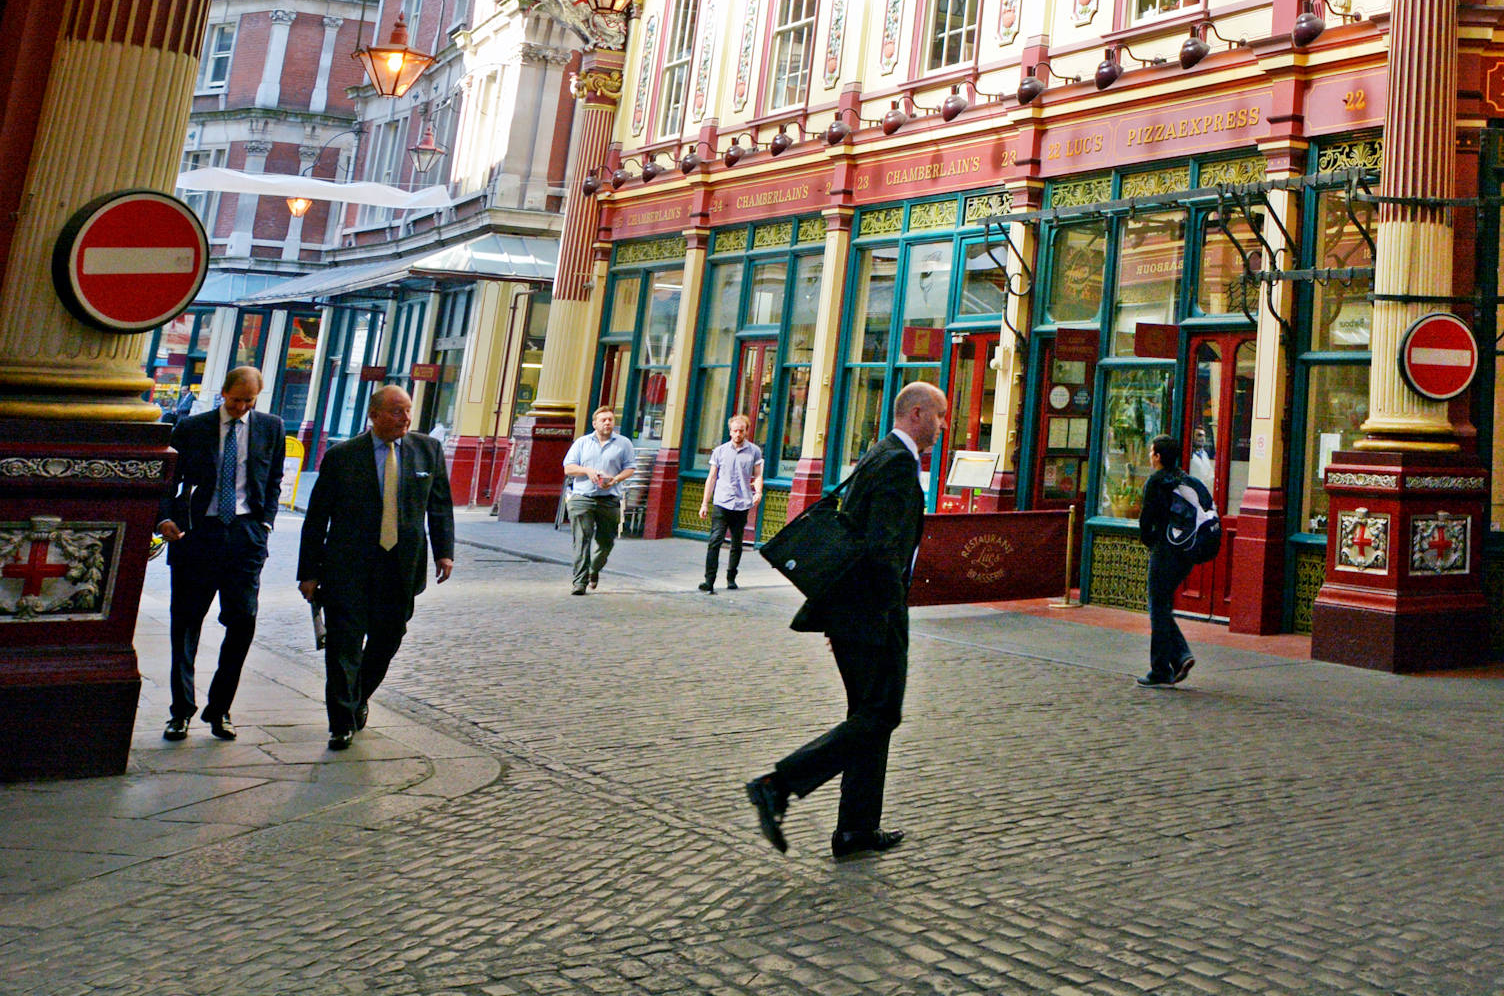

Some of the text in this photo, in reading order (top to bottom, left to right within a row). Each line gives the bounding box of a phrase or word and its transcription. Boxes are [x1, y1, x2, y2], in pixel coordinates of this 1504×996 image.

[1344, 89, 1367, 111] 22
[1127, 106, 1261, 146] PIZZAEXPRESS
[1047, 134, 1104, 160] 22 LUC'S
[857, 150, 1017, 191] 23 CHAMBERLAIN'S 23
[736, 184, 809, 210] CHAMBERLAIN'S
[627, 207, 682, 226] CHAMBERLAIN'S
